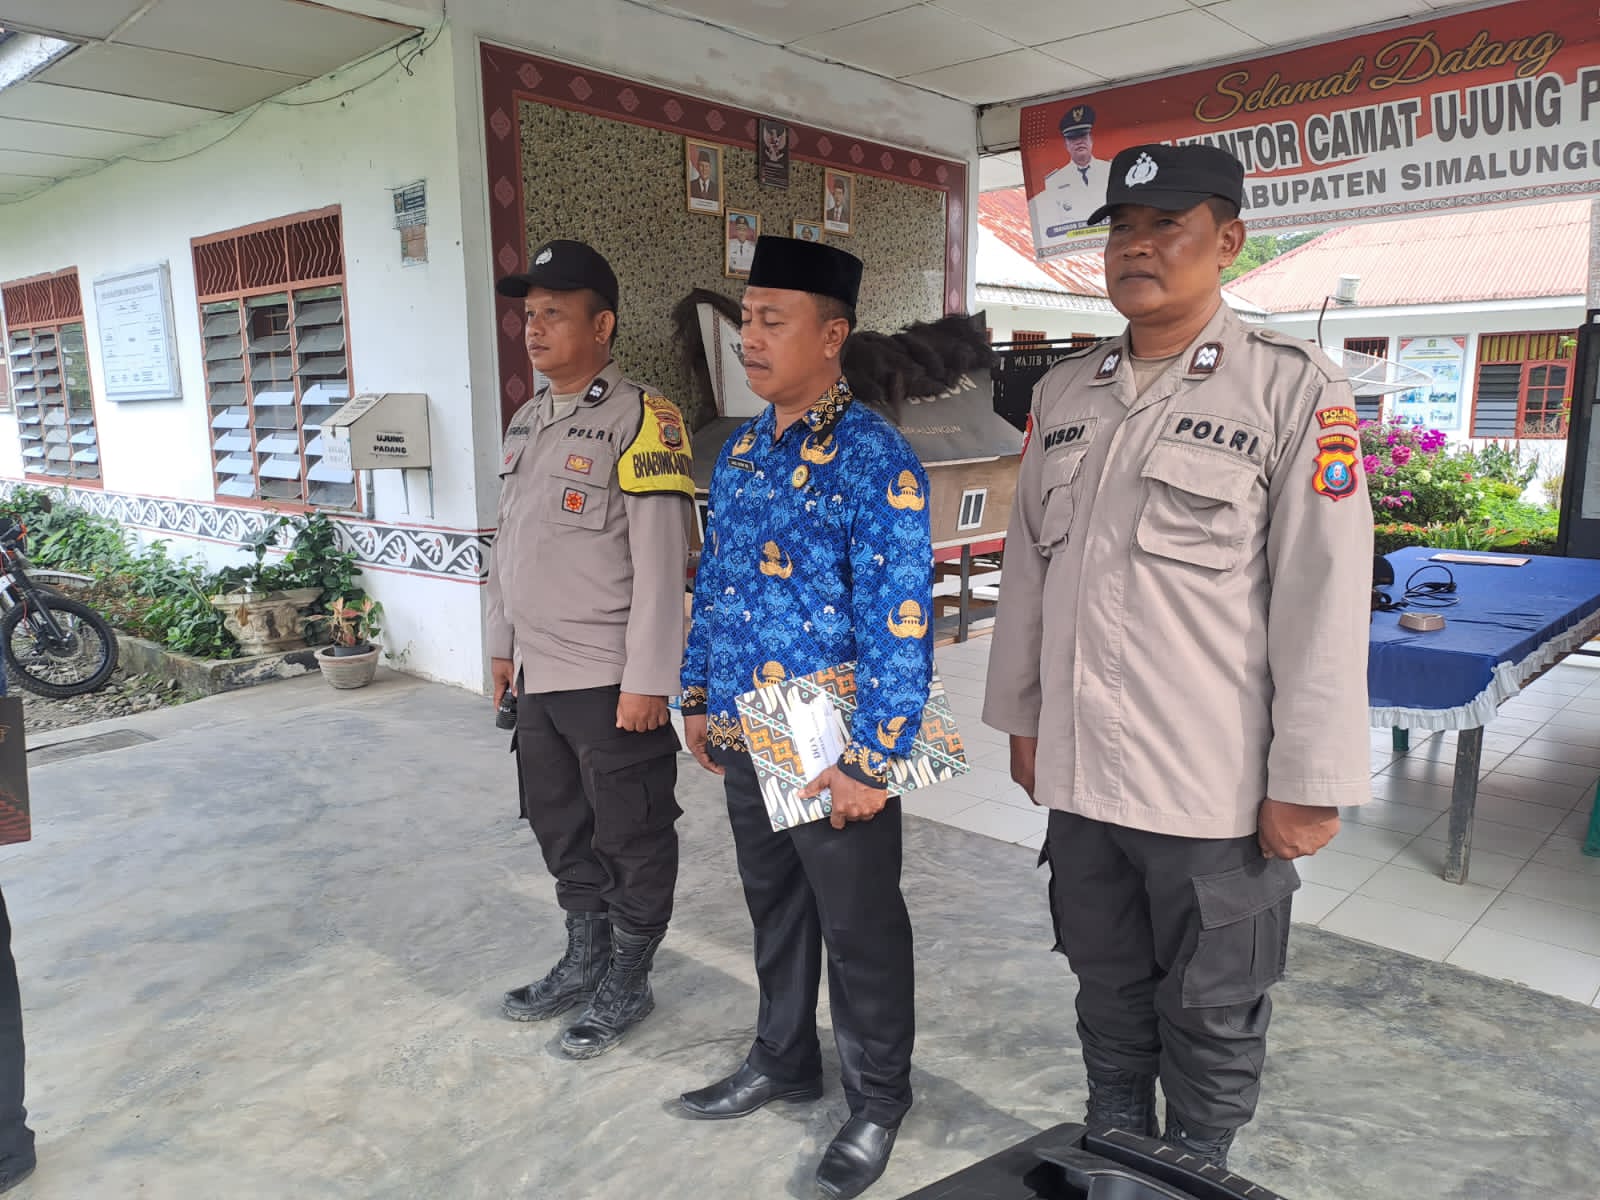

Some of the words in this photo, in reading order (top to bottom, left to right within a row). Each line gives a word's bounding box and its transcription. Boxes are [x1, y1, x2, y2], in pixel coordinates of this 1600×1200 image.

[1194, 56, 1366, 122] Selamat
[1368, 31, 1563, 89] Datang
[1306, 100, 1418, 162] CAMAT
[1434, 75, 1562, 143] UJUNG
[1240, 168, 1387, 210] ABUPATEN
[1014, 354, 1043, 367] WAJIB
[376, 434, 405, 443] UJUNG
[567, 427, 614, 442] POLRI
[1175, 417, 1259, 455] POLRI
[373, 444, 407, 454] PADANG
